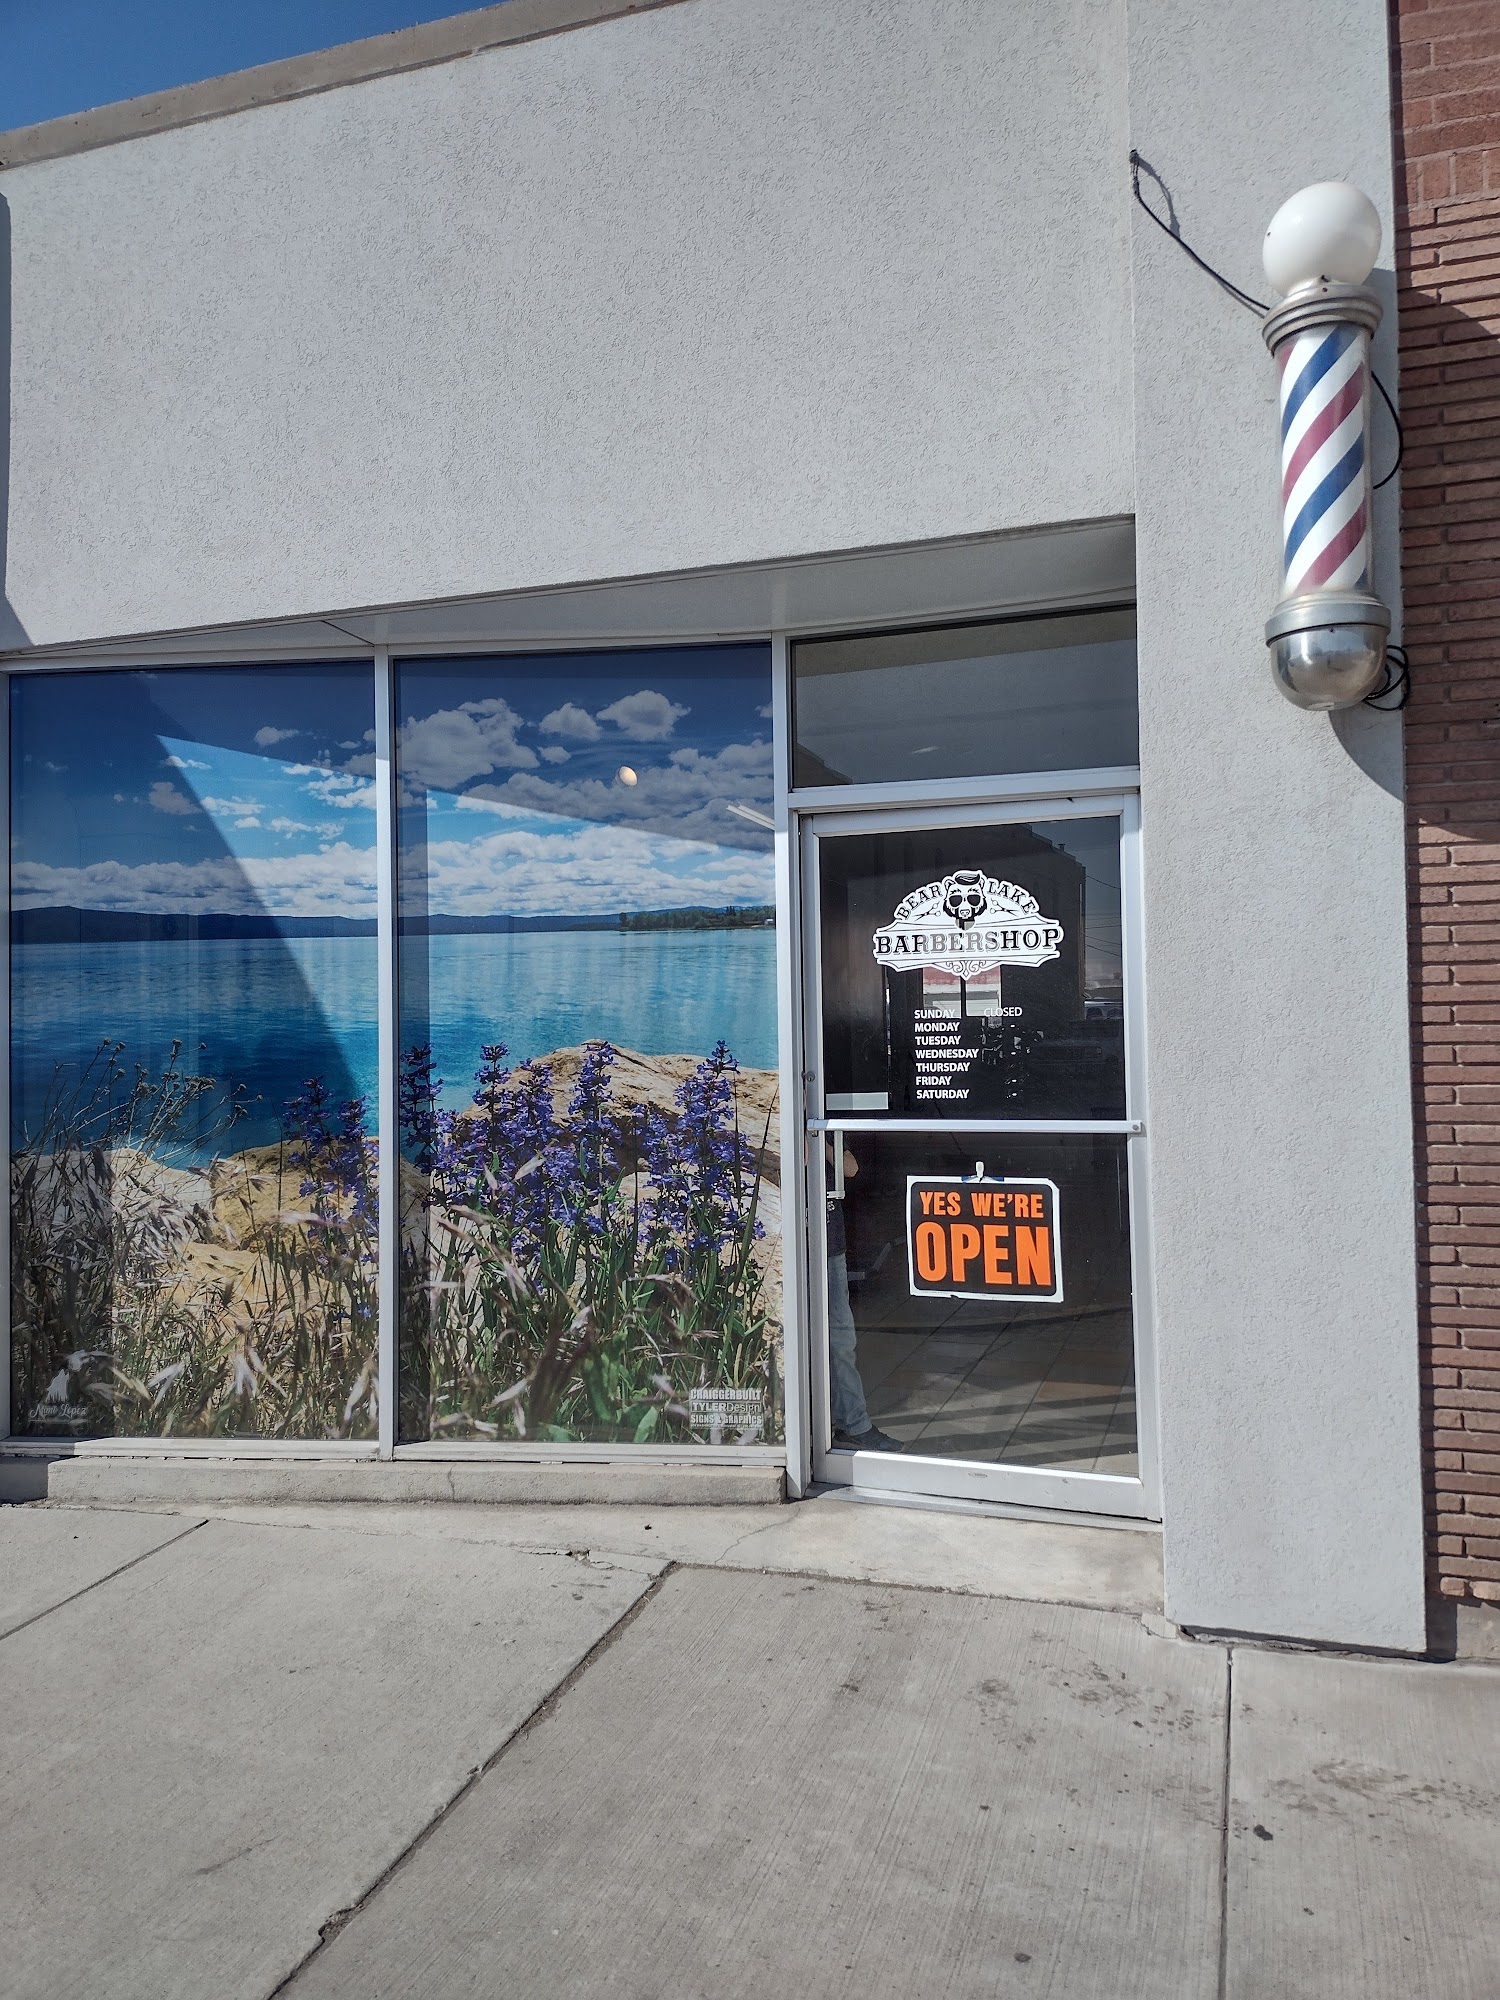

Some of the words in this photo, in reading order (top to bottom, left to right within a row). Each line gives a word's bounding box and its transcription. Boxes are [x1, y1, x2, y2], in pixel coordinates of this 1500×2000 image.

[897, 884, 943, 920] BEAR
[987, 881, 1037, 914] LAKE
[875, 929, 1060, 956] BARBERSHOP
[914, 1009, 955, 1019] SUNDAY
[984, 1007, 1022, 1017] CLOSED
[914, 1022, 960, 1032] MONDAY
[915, 1036, 961, 1045] TUESDAY
[915, 1049, 979, 1059] WEDNESDAY
[916, 1062, 970, 1072] THURSDAY
[916, 1076, 952, 1086] FRIDAY
[916, 1089, 969, 1099] SATURDAY
[919, 1191, 961, 1216] YES
[971, 1191, 1044, 1219] WE'RE
[915, 1221, 1052, 1286] OPEN
[690, 1414, 714, 1424] SIGNS
[724, 1415, 762, 1424] GRAPHICS
